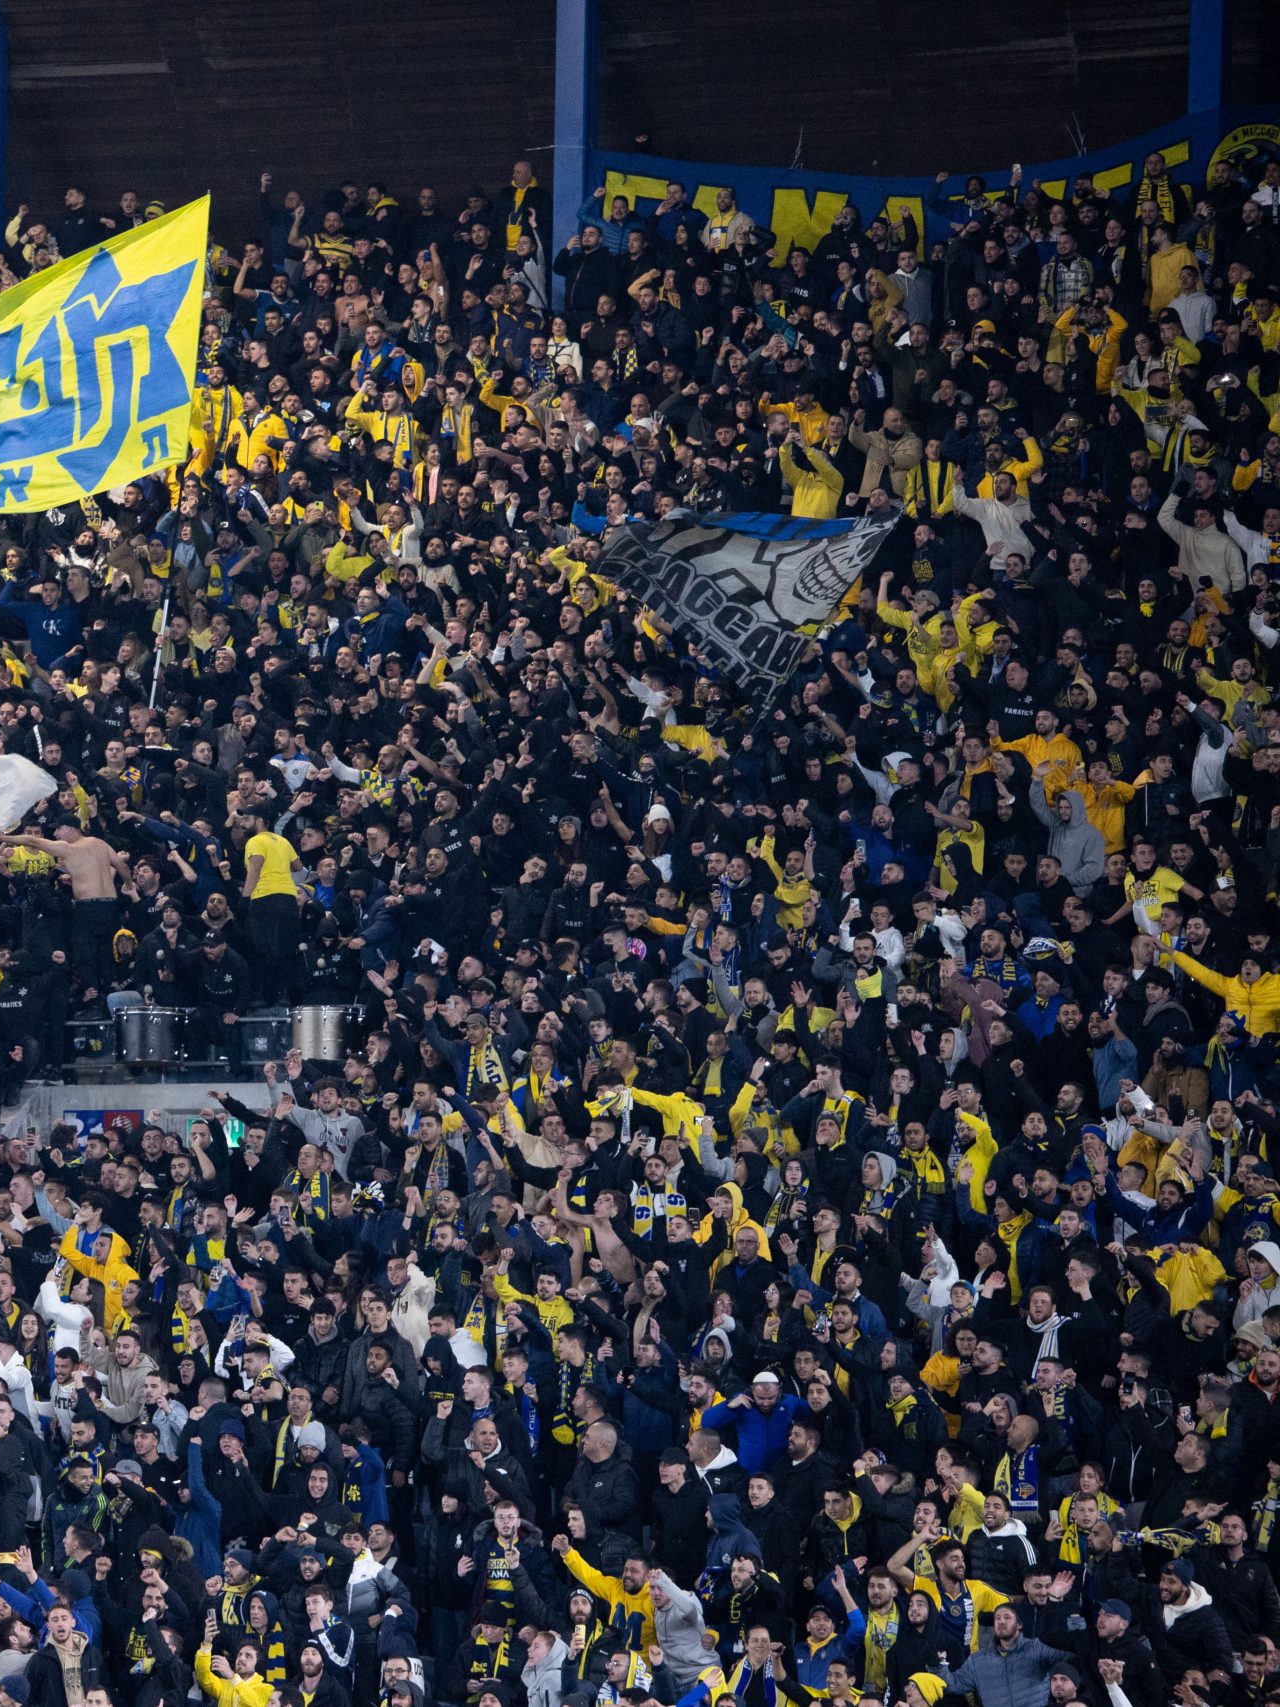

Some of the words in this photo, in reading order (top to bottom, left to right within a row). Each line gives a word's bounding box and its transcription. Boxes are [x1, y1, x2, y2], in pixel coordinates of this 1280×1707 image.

[787, 286, 809, 298] ARIS
[42, 619, 62, 636] CK
[1004, 706, 1034, 717] FANATICS
